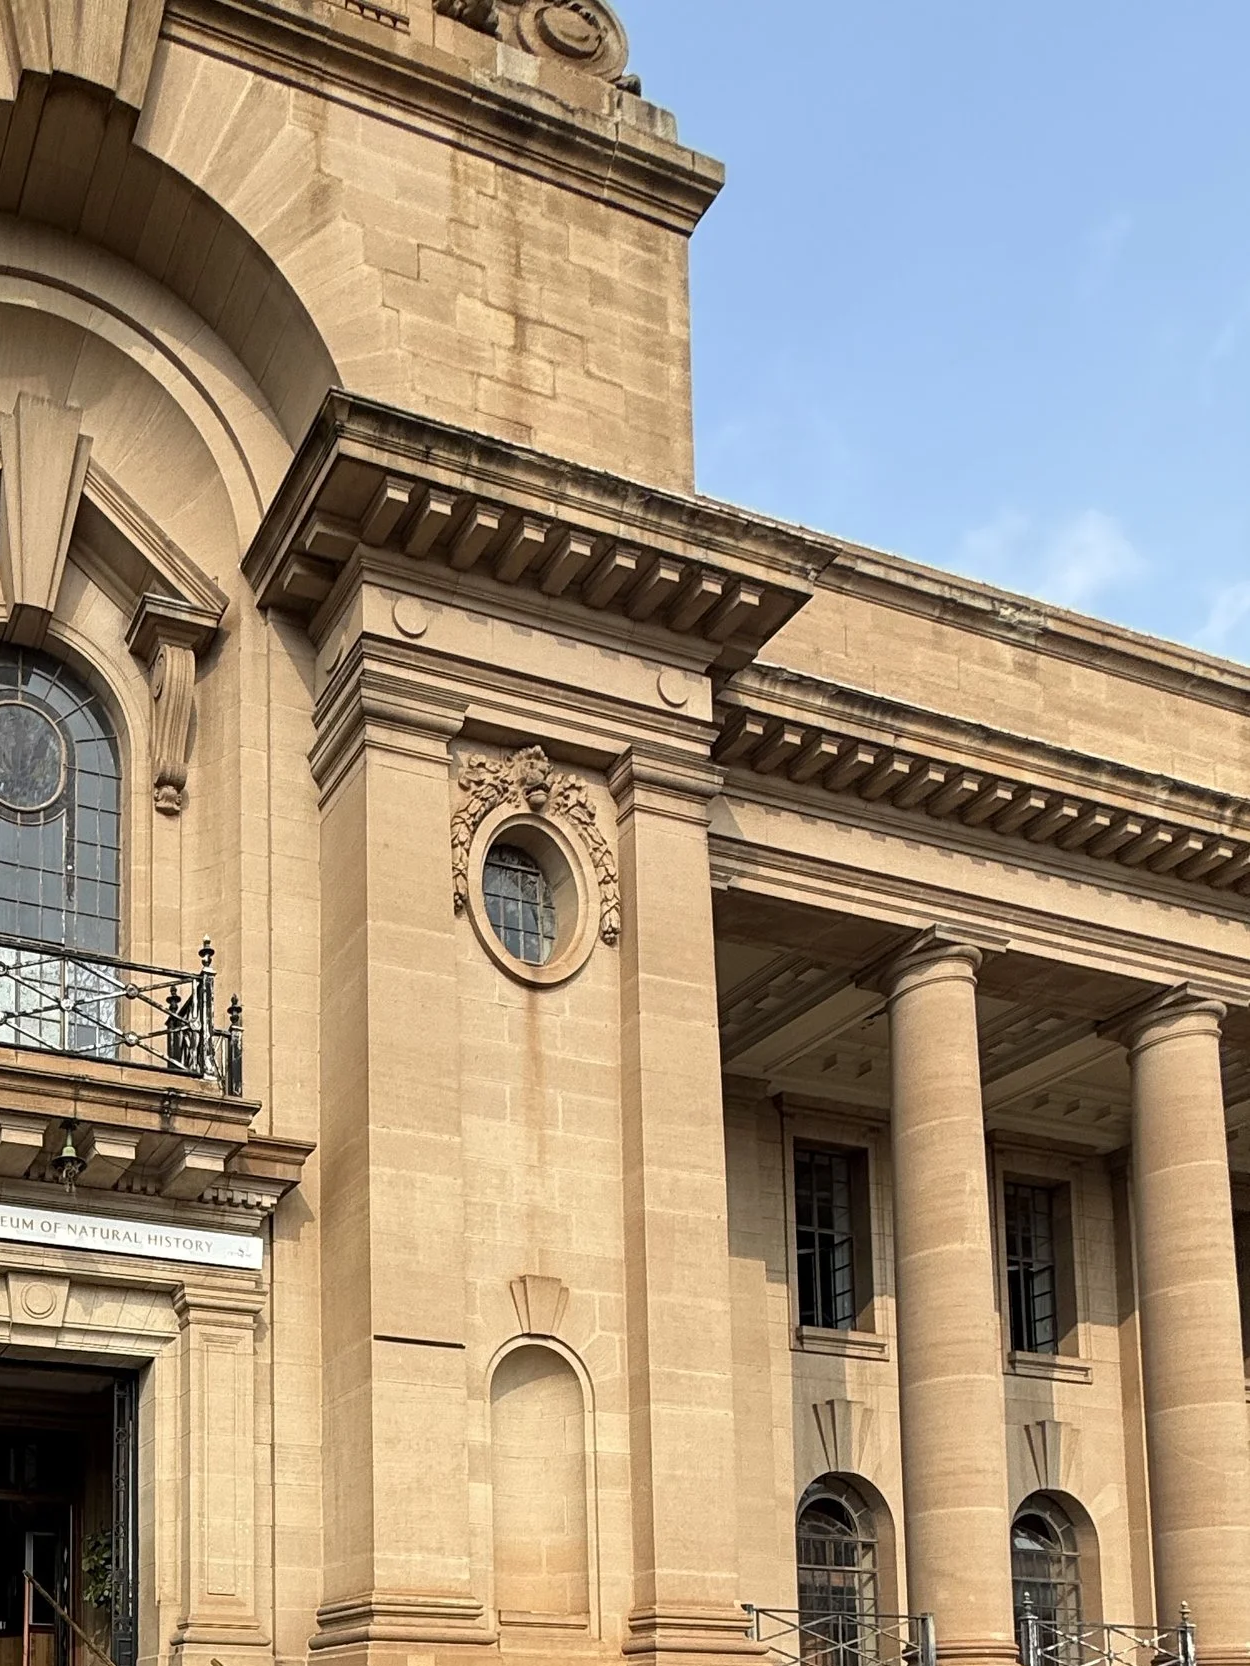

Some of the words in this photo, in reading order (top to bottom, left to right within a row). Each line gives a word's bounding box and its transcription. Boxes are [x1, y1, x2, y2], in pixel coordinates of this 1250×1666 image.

[40, 1220, 61, 1233] OF
[67, 1224, 142, 1244] NATURAL
[147, 1234, 213, 1252] HISTORY
